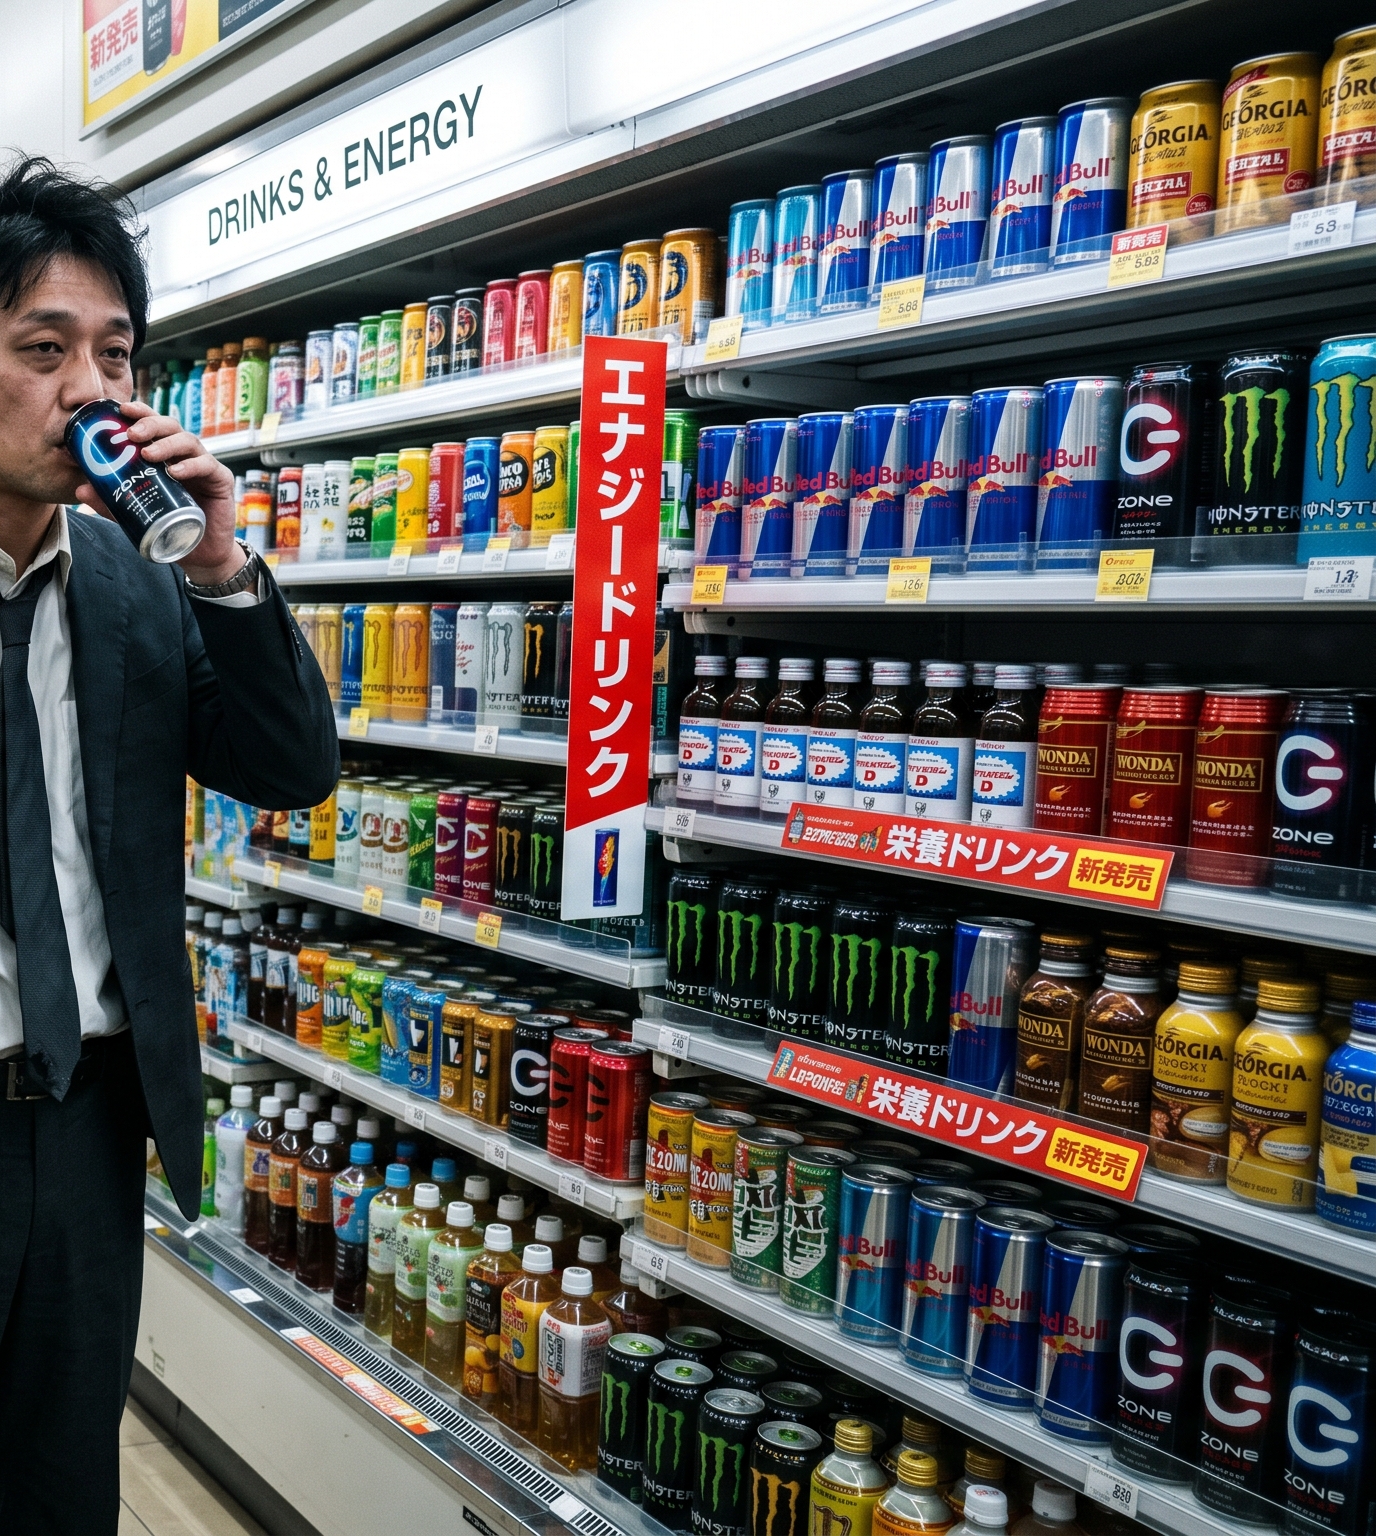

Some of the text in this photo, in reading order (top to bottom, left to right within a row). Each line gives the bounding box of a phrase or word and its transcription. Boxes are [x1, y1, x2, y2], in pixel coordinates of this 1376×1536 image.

[90, 7, 138, 71] 新発売
[208, 84, 483, 246] DRINKS & ENERGY
[1069, 157, 1110, 181] Bull
[1005, 174, 1044, 197] Bull
[935, 191, 970, 214] Bull
[884, 206, 919, 228] Bull
[835, 220, 868, 240] Bull
[986, 453, 1028, 475] Bull
[1055, 445, 1097, 468] Bull
[585, 359, 645, 798] エナジードリンク
[682, 749, 693, 760] D
[722, 754, 732, 765] D
[768, 759, 780, 771] D
[1038, 749, 1092, 765] WONDA
[1117, 754, 1175, 772] WONDA
[814, 764, 826, 776] D
[864, 770, 876, 781] D
[915, 774, 928, 786] D
[1197, 761, 1256, 779] WONDA
[980, 780, 993, 792] D
[883, 824, 1069, 881] 栄養ドリンク
[1075, 855, 1156, 892] 新発売
[959, 992, 1002, 1017] Bull
[1086, 1034, 1146, 1057] WONDA
[867, 1076, 1048, 1155] 栄養ドリンク
[1053, 1136, 1130, 1182] 新発売
[856, 1237, 896, 1258] Bull
[926, 1262, 965, 1284] Bull
[990, 1288, 1032, 1311] Bull
[1063, 1315, 1109, 1341] Bull
